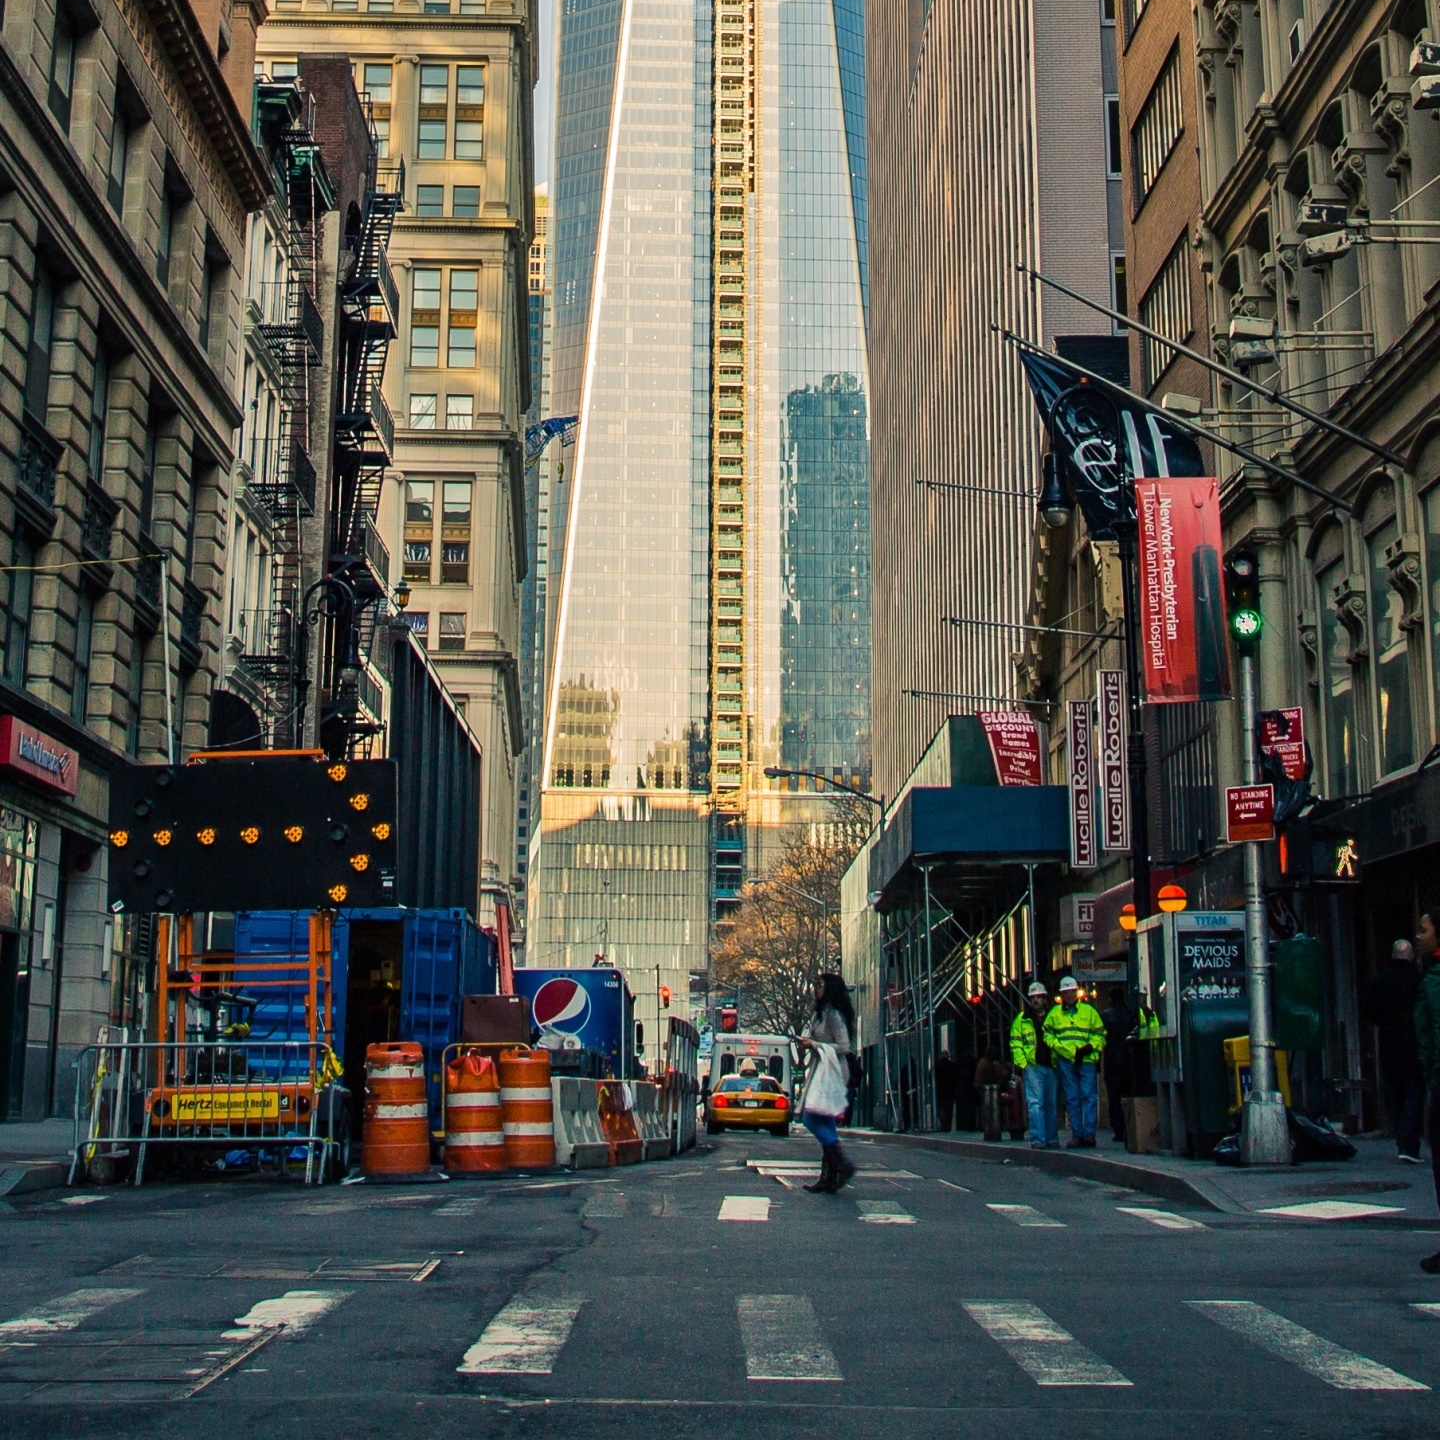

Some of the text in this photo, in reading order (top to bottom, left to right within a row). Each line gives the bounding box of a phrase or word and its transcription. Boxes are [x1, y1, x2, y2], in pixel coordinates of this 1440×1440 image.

[1159, 498, 1177, 640] NewYork-Presbyterian
[1144, 493, 1166, 669] Lower Manhattan Hospital
[981, 712, 1034, 724] GLOBAL
[985, 724, 1034, 732] DISCOUNT
[999, 750, 1037, 762] Incredibly
[1104, 672, 1122, 847] Lucille Roberts
[1073, 703, 1091, 865] Lucille Roberts
[1230, 789, 1269, 801] NO STANDING
[1235, 801, 1264, 811] ANYTIME
[1080, 923, 1094, 931] FO
[1194, 916, 1226, 926] TITAN
[1184, 945, 1238, 958] DEVIOUS
[1192, 957, 1231, 969] MAIDS
[179, 1099, 212, 1110] Hertz
